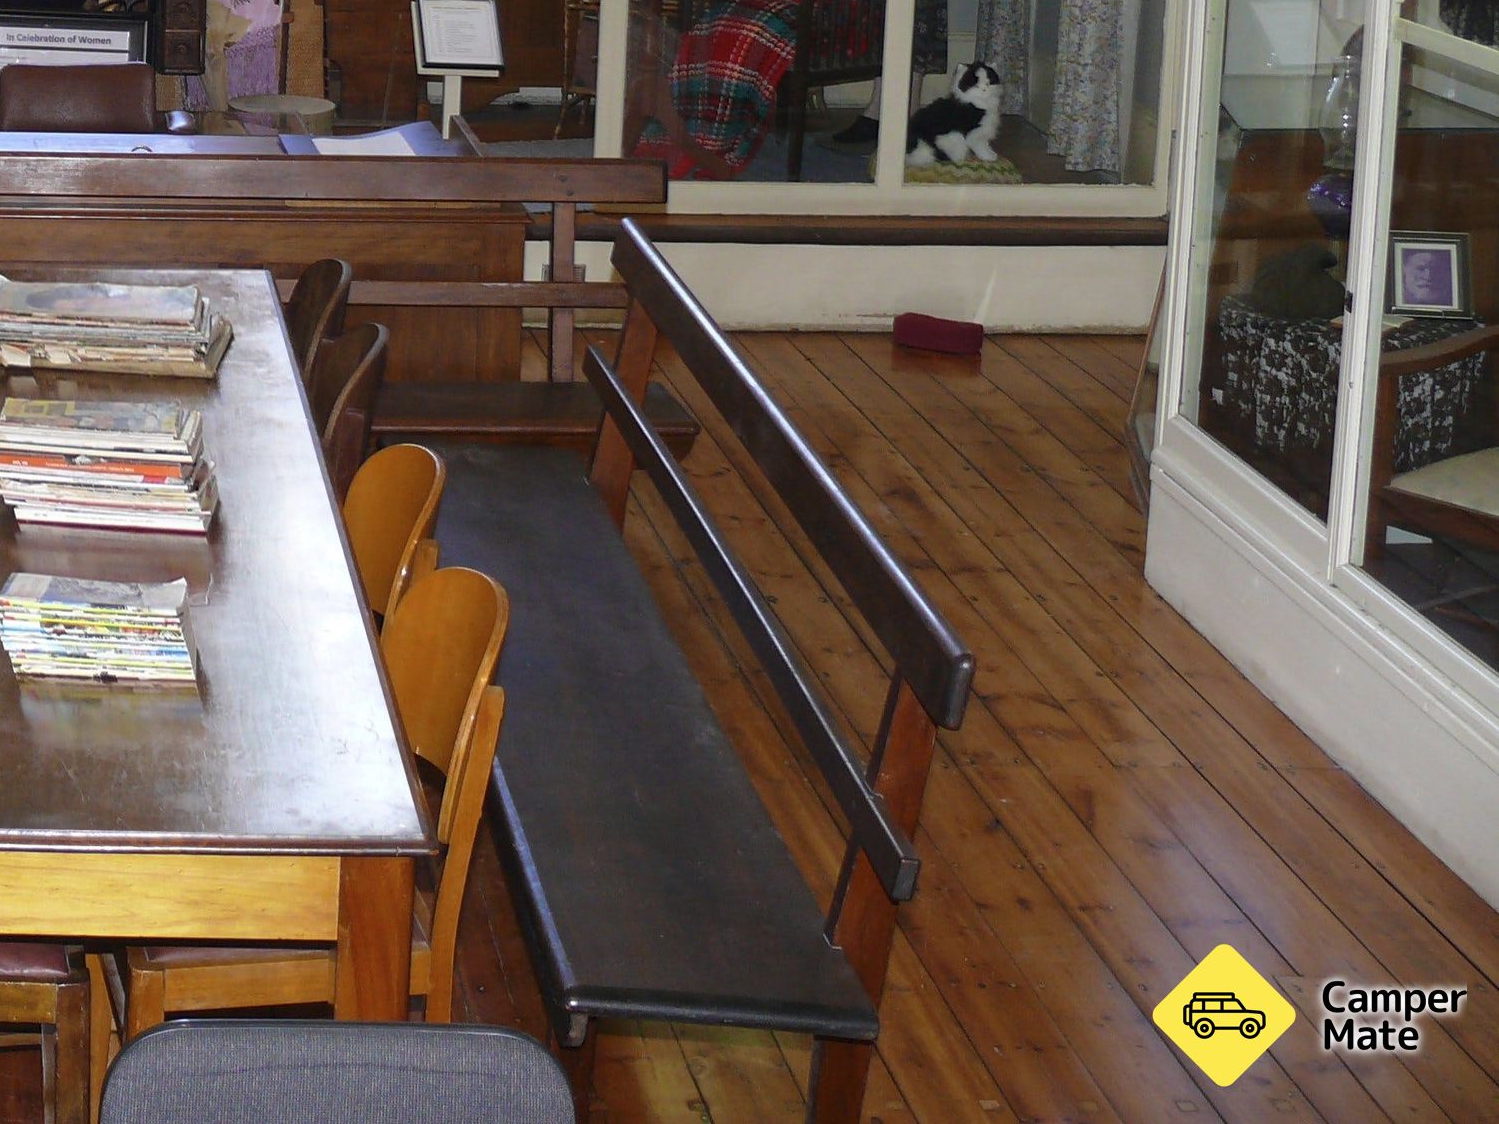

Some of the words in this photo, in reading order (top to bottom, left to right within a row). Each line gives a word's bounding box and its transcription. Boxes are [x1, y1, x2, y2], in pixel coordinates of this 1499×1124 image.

[6, 33, 15, 42] In
[16, 33, 65, 44] Celebration
[68, 35, 77, 44] of
[77, 36, 112, 45] Women
